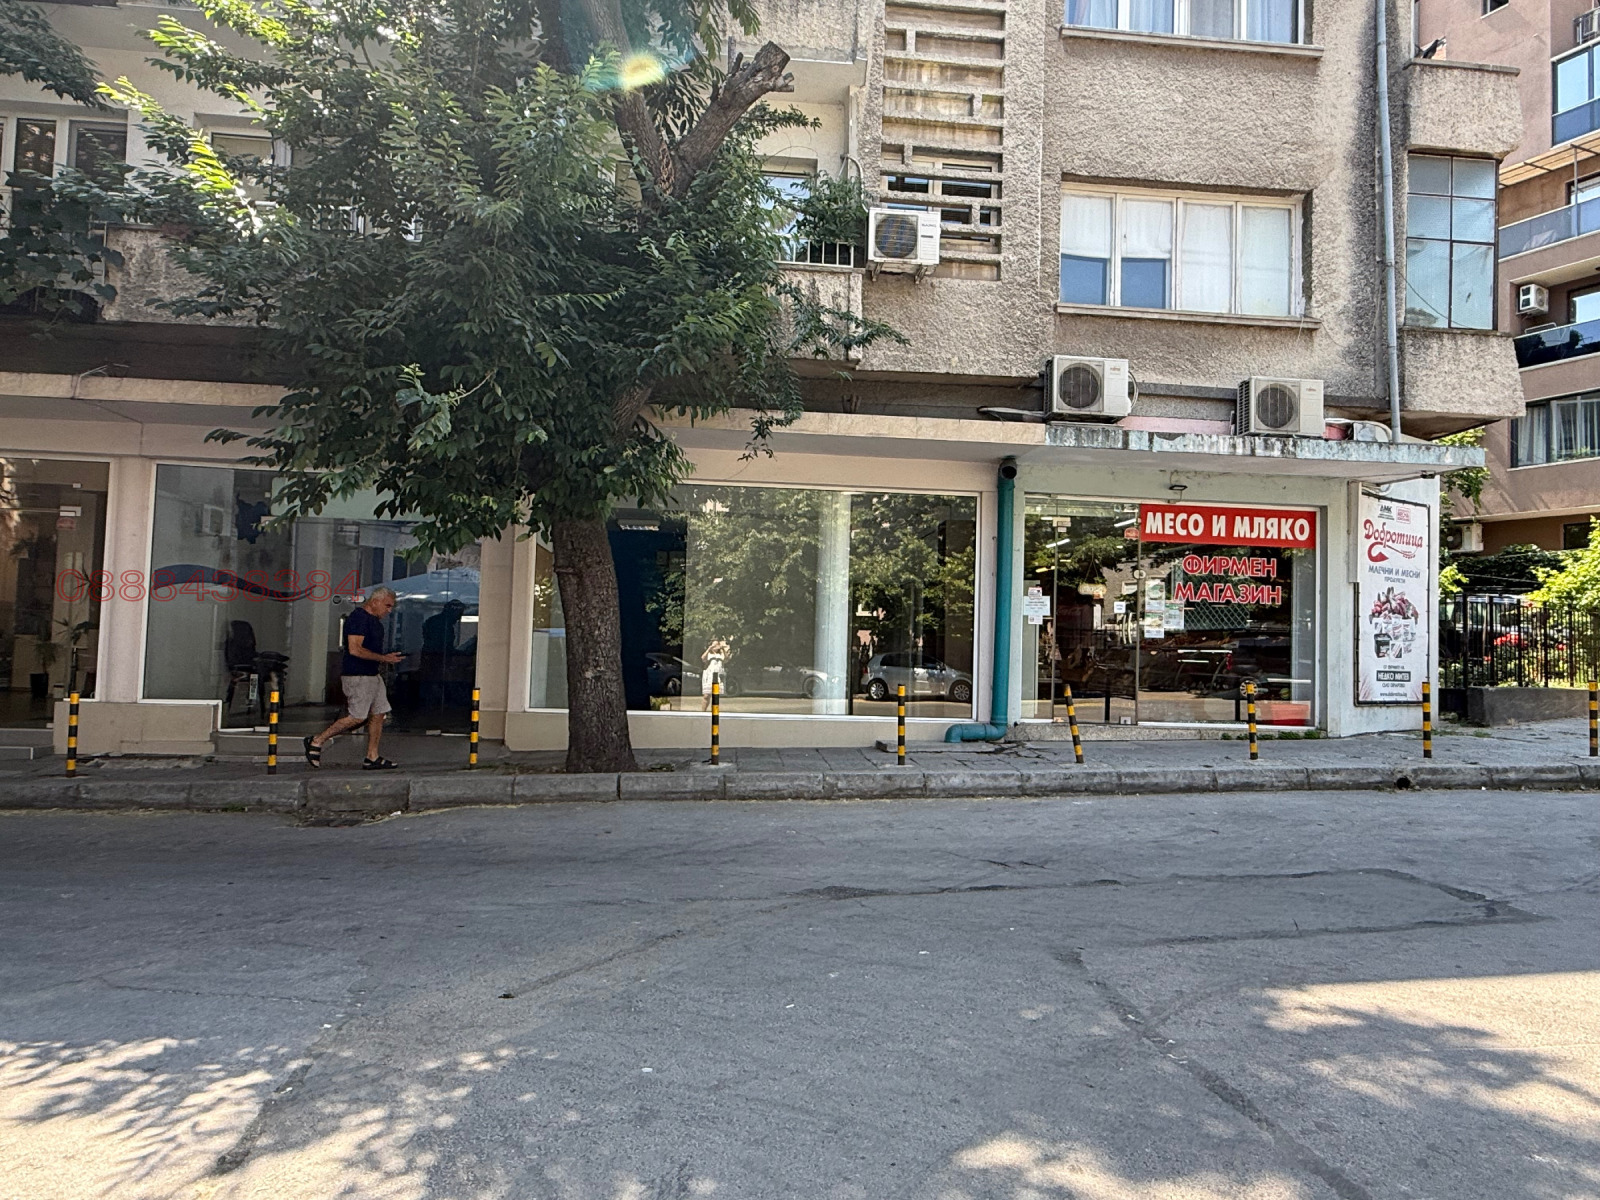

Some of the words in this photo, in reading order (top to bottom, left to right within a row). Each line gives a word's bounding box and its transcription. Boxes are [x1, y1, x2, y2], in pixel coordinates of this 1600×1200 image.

[1145, 511, 1205, 537] МЕСО
[1212, 514, 1226, 537] И
[1233, 515, 1310, 541] МЛЯКО
[1363, 518, 1424, 548] Добротица
[1182, 554, 1277, 578] ФИРМЕН
[1401, 569, 1421, 578] МЕСНИ
[1173, 582, 1282, 605] МАГАЗИН
